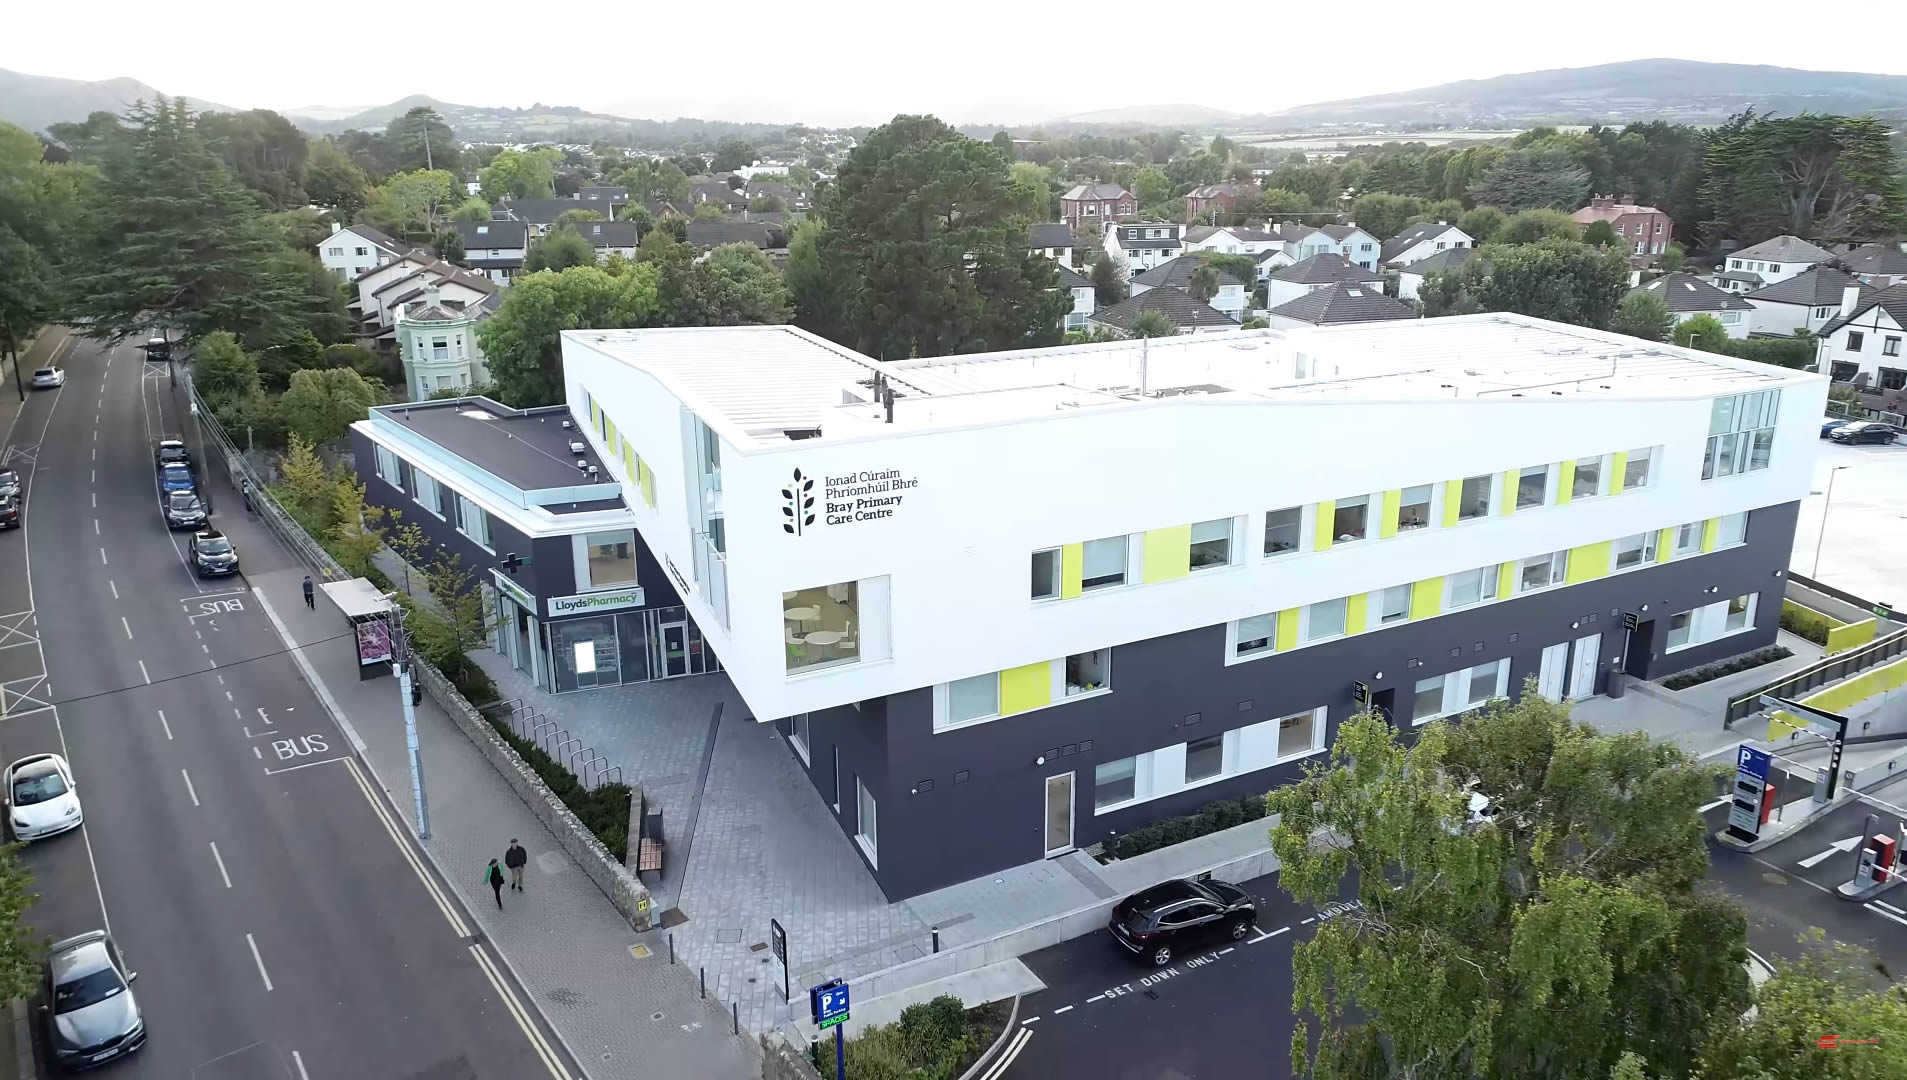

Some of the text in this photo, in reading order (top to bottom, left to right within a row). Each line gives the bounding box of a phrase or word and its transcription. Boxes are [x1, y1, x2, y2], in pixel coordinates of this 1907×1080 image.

[825, 468, 900, 487] Ionad Cúraim
[825, 477, 918, 499] Phríomhúil Bhré
[826, 496, 903, 513] Bray Primary
[826, 509, 893, 525] Care Centre
[200, 598, 244, 615] BUS
[555, 592, 637, 611] LloydsPharmacy
[271, 734, 329, 760] BUS
[1740, 749, 1752, 764] P
[1104, 951, 1220, 999] SET DOWN ONLY
[822, 995, 832, 1011] P
[821, 1013, 848, 1028] SPACES
